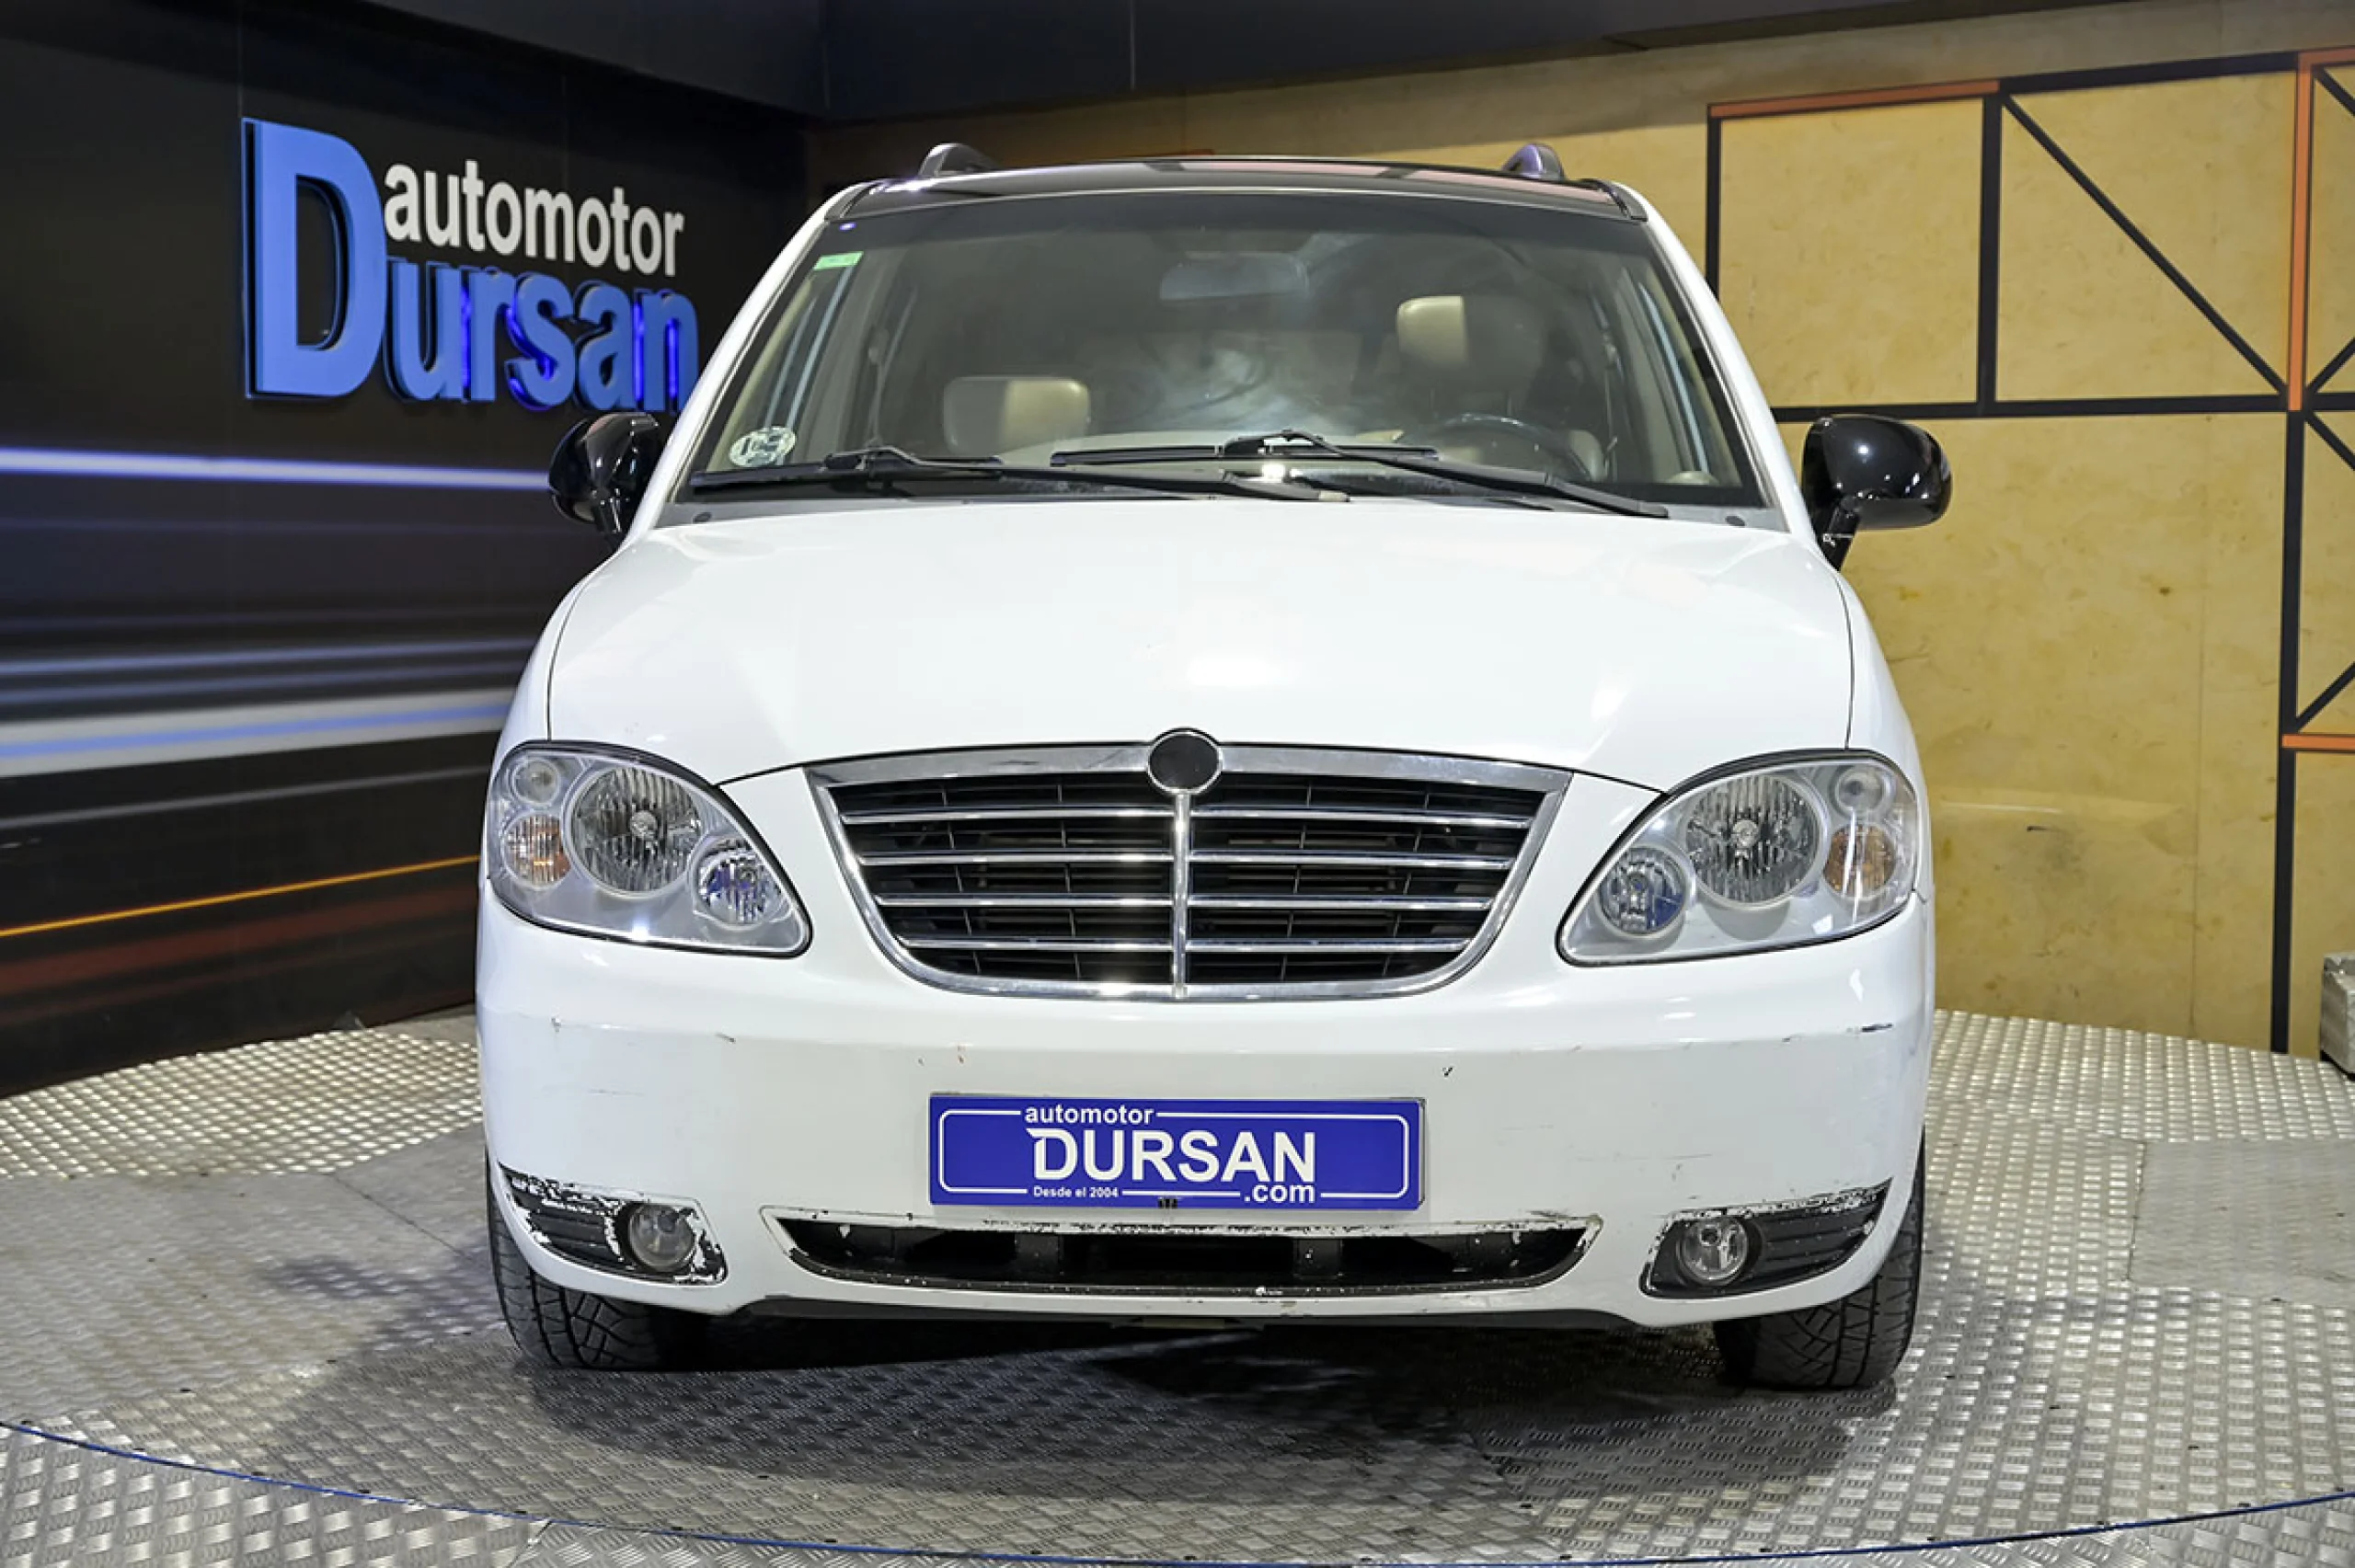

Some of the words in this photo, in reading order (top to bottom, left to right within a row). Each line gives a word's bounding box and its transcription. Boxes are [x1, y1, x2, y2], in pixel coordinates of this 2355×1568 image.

[385, 160, 684, 276] automotor
[241, 117, 699, 414] Dursan
[1024, 1104, 1154, 1125] automotor
[1026, 1127, 1315, 1183] DURSAN
[1032, 1185, 1073, 1197] Desde
[1075, 1186, 1086, 1197] el
[1090, 1186, 1120, 1198] 2004
[1244, 1183, 1315, 1203] .com
